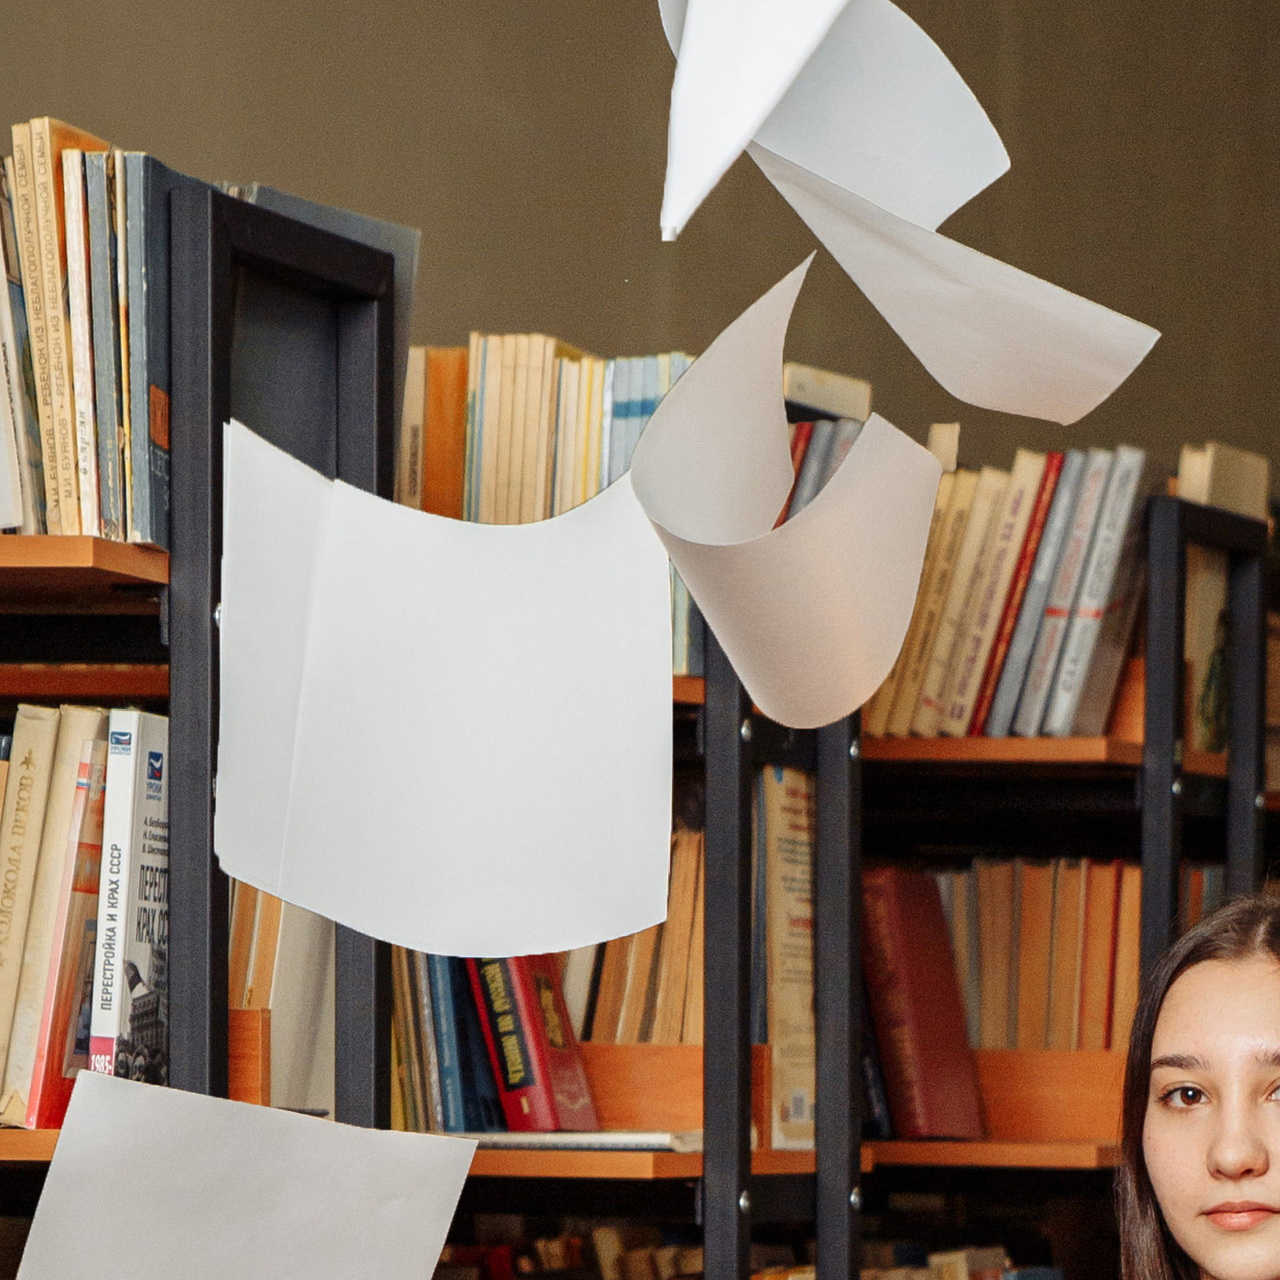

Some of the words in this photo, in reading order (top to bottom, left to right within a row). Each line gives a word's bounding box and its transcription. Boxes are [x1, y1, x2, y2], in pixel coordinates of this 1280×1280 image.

[110, 843, 122, 875] СССР
[107, 880, 120, 909] КРАХ
[106, 913, 118, 921] И
[100, 927, 117, 1011] ПЕРЕСТРОЙКА
